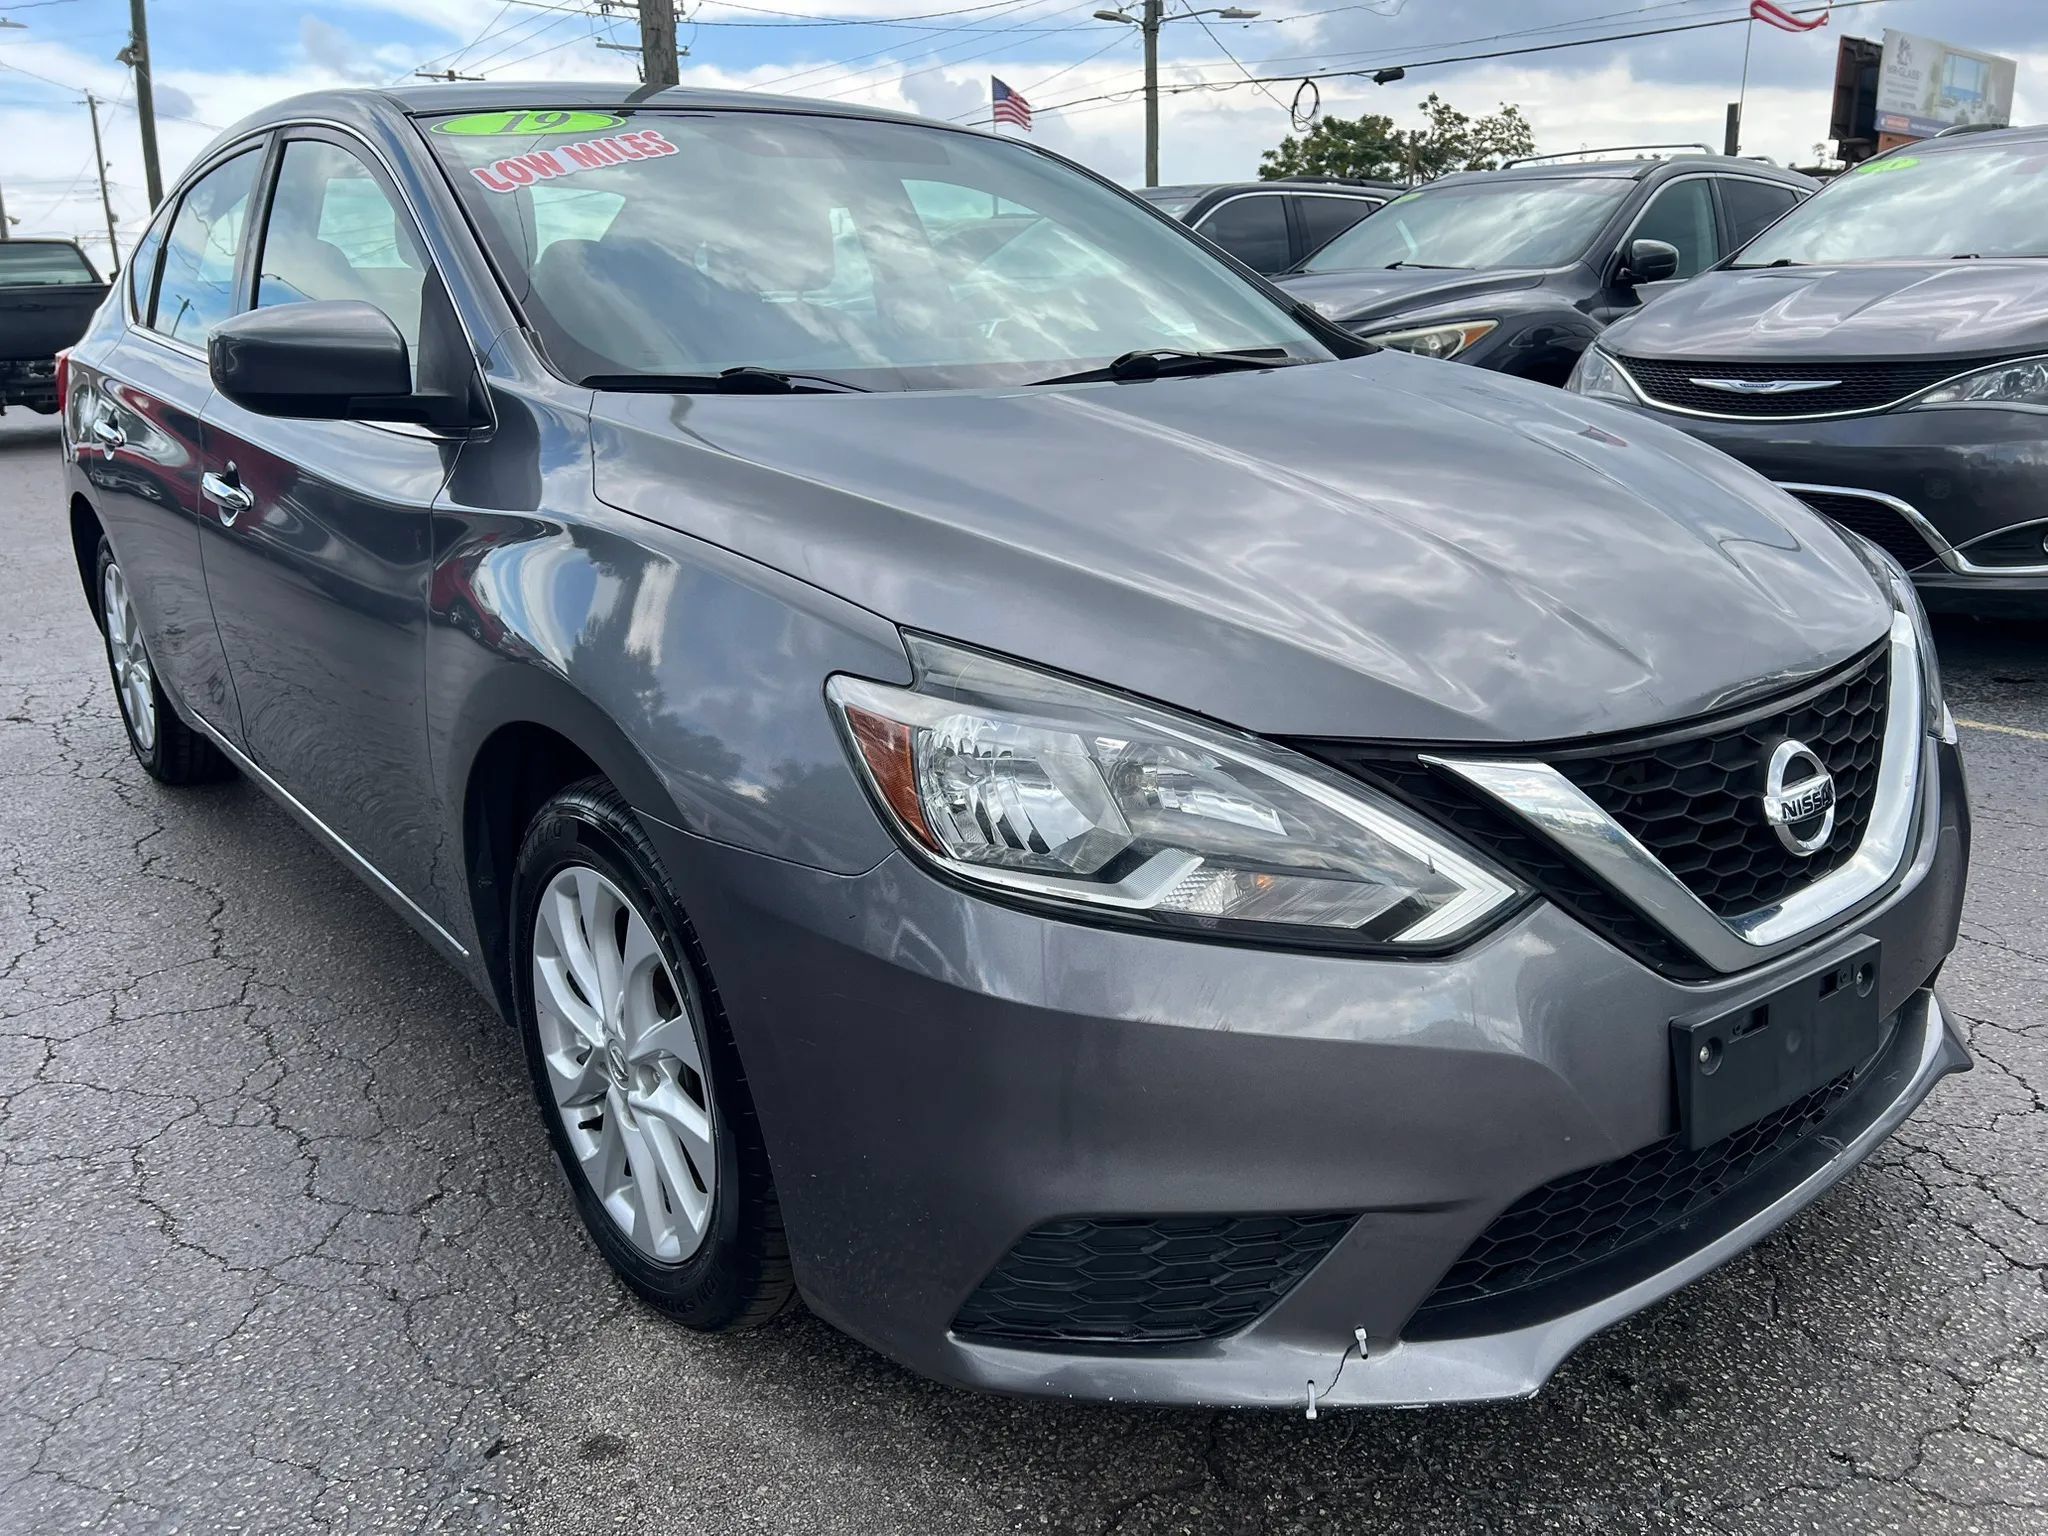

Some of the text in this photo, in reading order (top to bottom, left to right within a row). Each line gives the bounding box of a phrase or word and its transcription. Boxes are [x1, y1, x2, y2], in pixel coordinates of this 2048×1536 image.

[493, 112, 572, 133] 19
[474, 132, 675, 191] LOW MILES
[1780, 786, 1831, 819] NISSA
